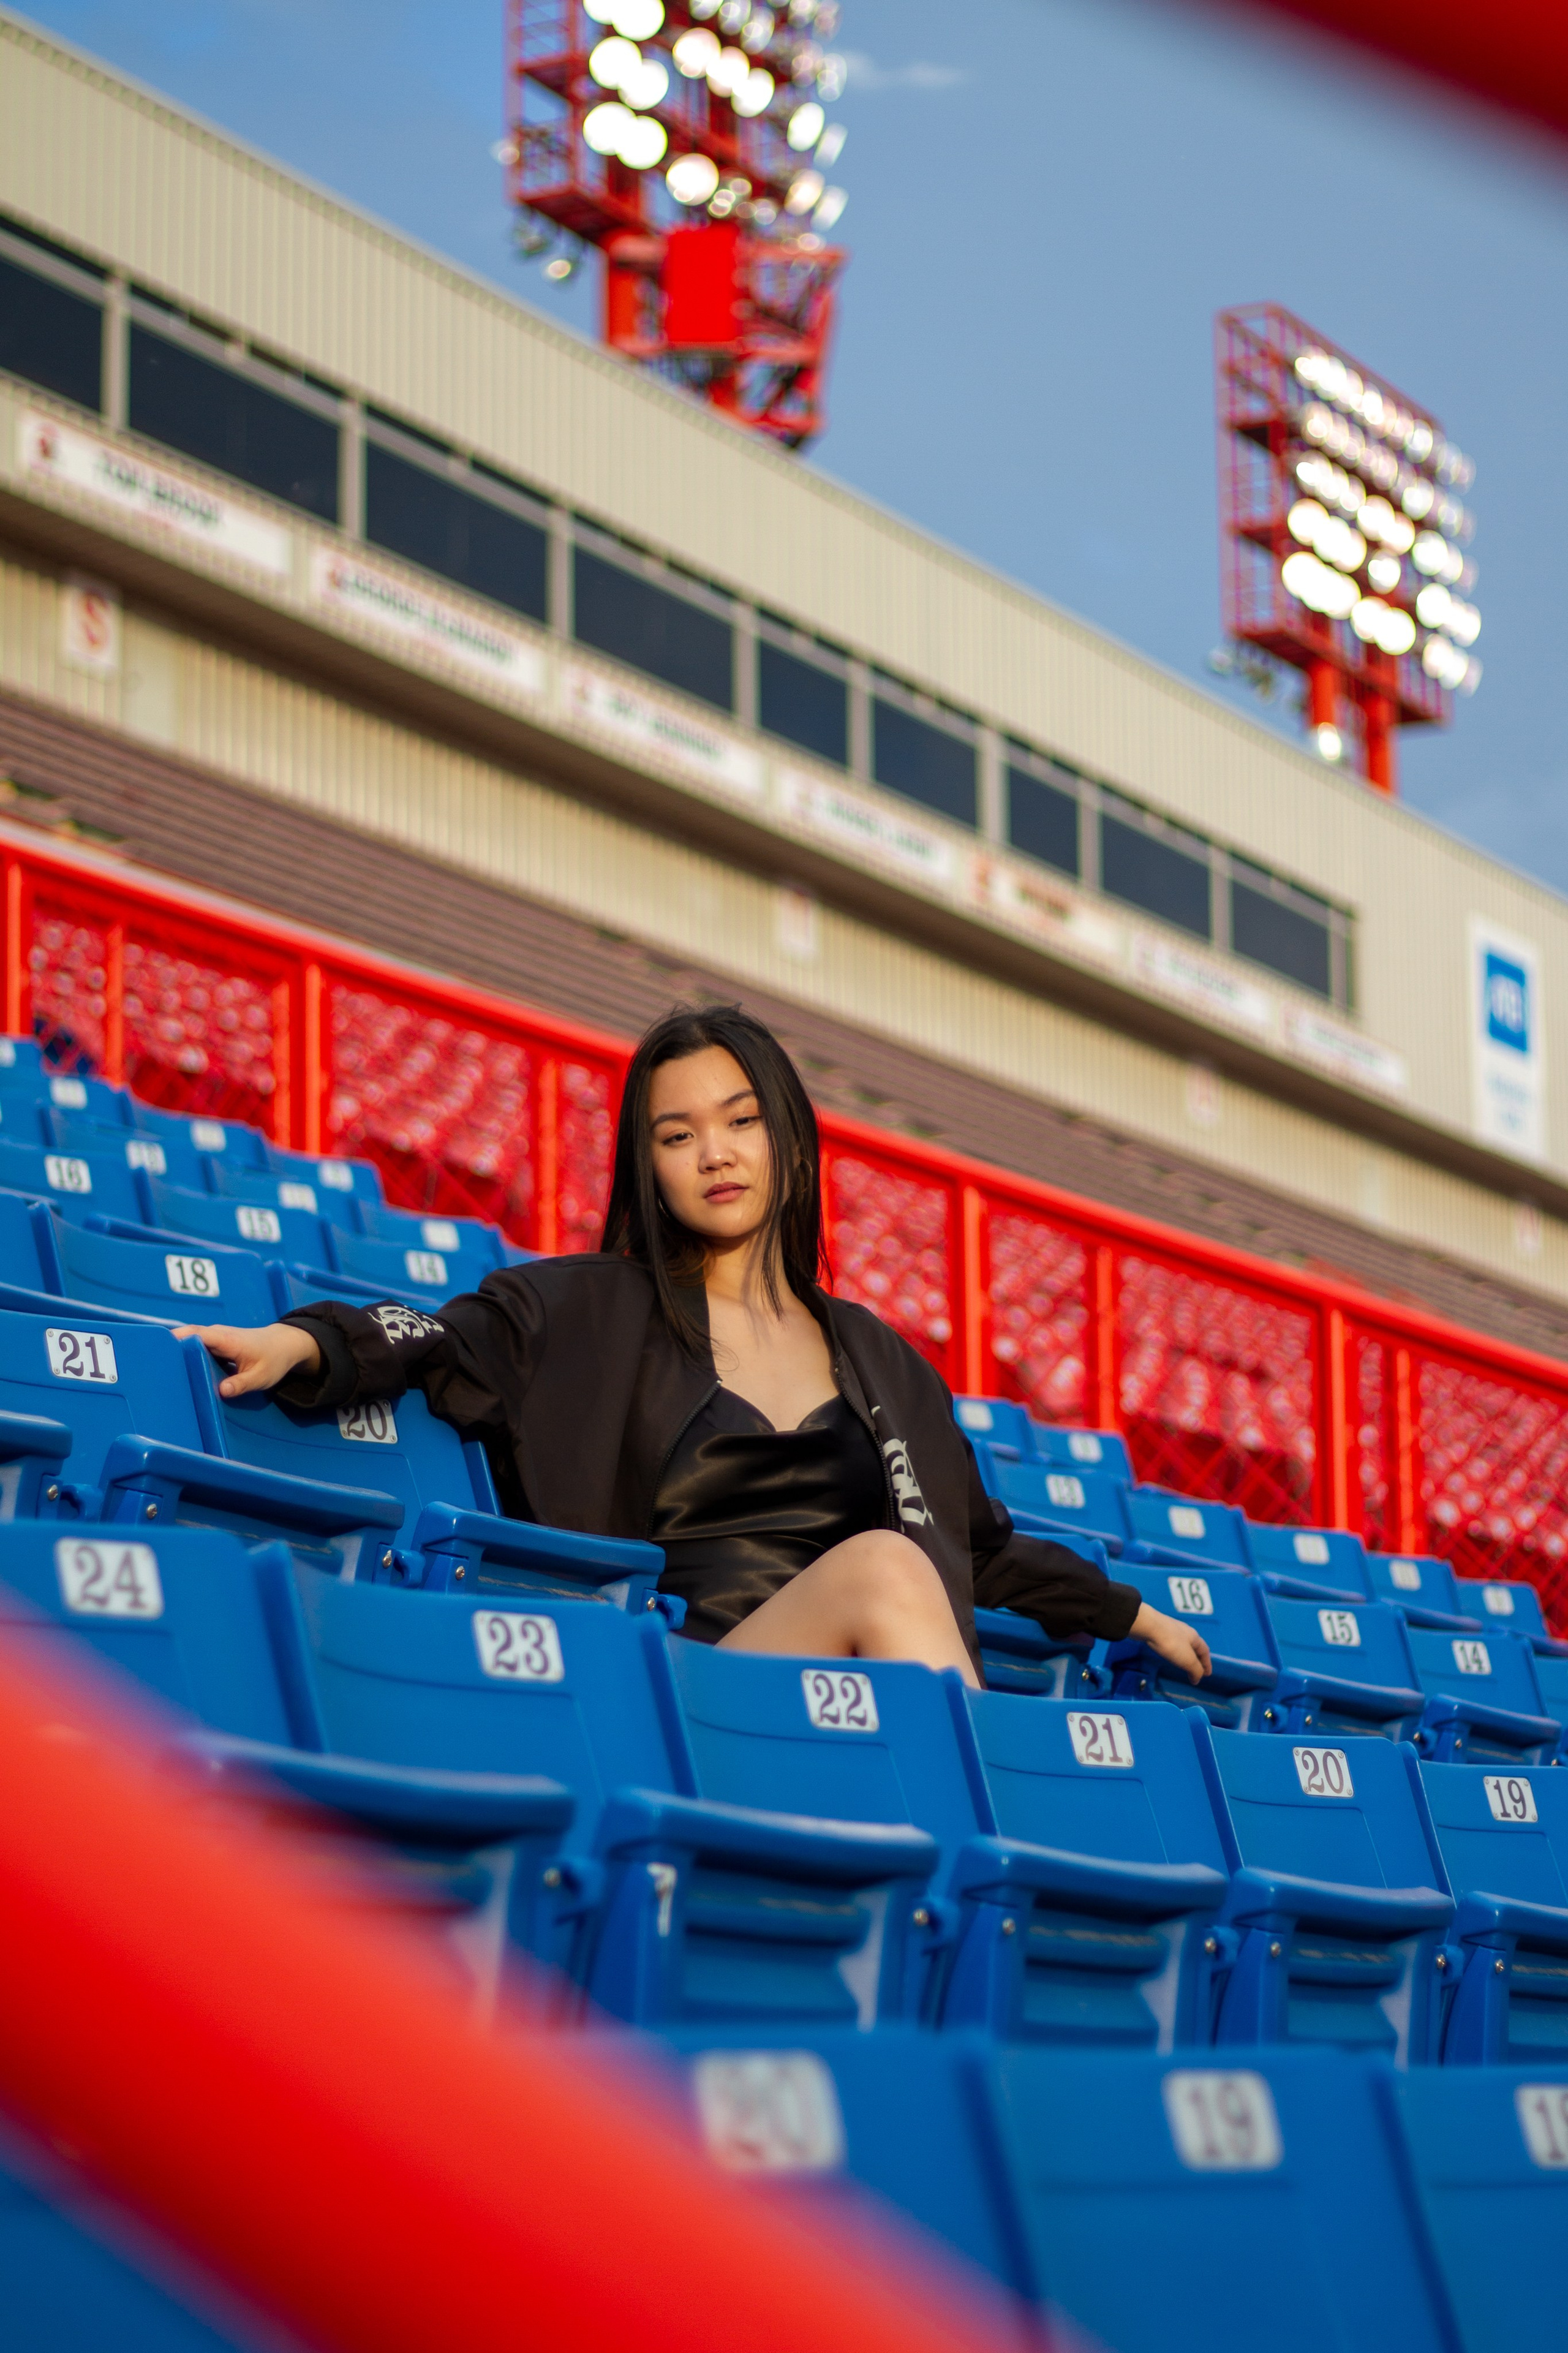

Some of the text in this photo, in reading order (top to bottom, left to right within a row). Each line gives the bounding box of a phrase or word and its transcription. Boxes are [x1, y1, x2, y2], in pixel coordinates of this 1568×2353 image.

[55, 1160, 83, 1188] 16
[176, 1258, 209, 1293] 18
[58, 1332, 105, 1378] 21
[343, 1400, 387, 1440] 20
[73, 1544, 148, 1610] 24
[1177, 1579, 1204, 1611] 16
[489, 1616, 549, 1675] 23
[1327, 1614, 1353, 1643] 15
[1460, 1645, 1484, 1672] 14
[813, 1673, 867, 1726] 22
[1079, 1715, 1123, 1764] 21
[1302, 1750, 1344, 1794] 20
[1493, 1779, 1526, 1819] 19
[1186, 2082, 1257, 2159] 19
